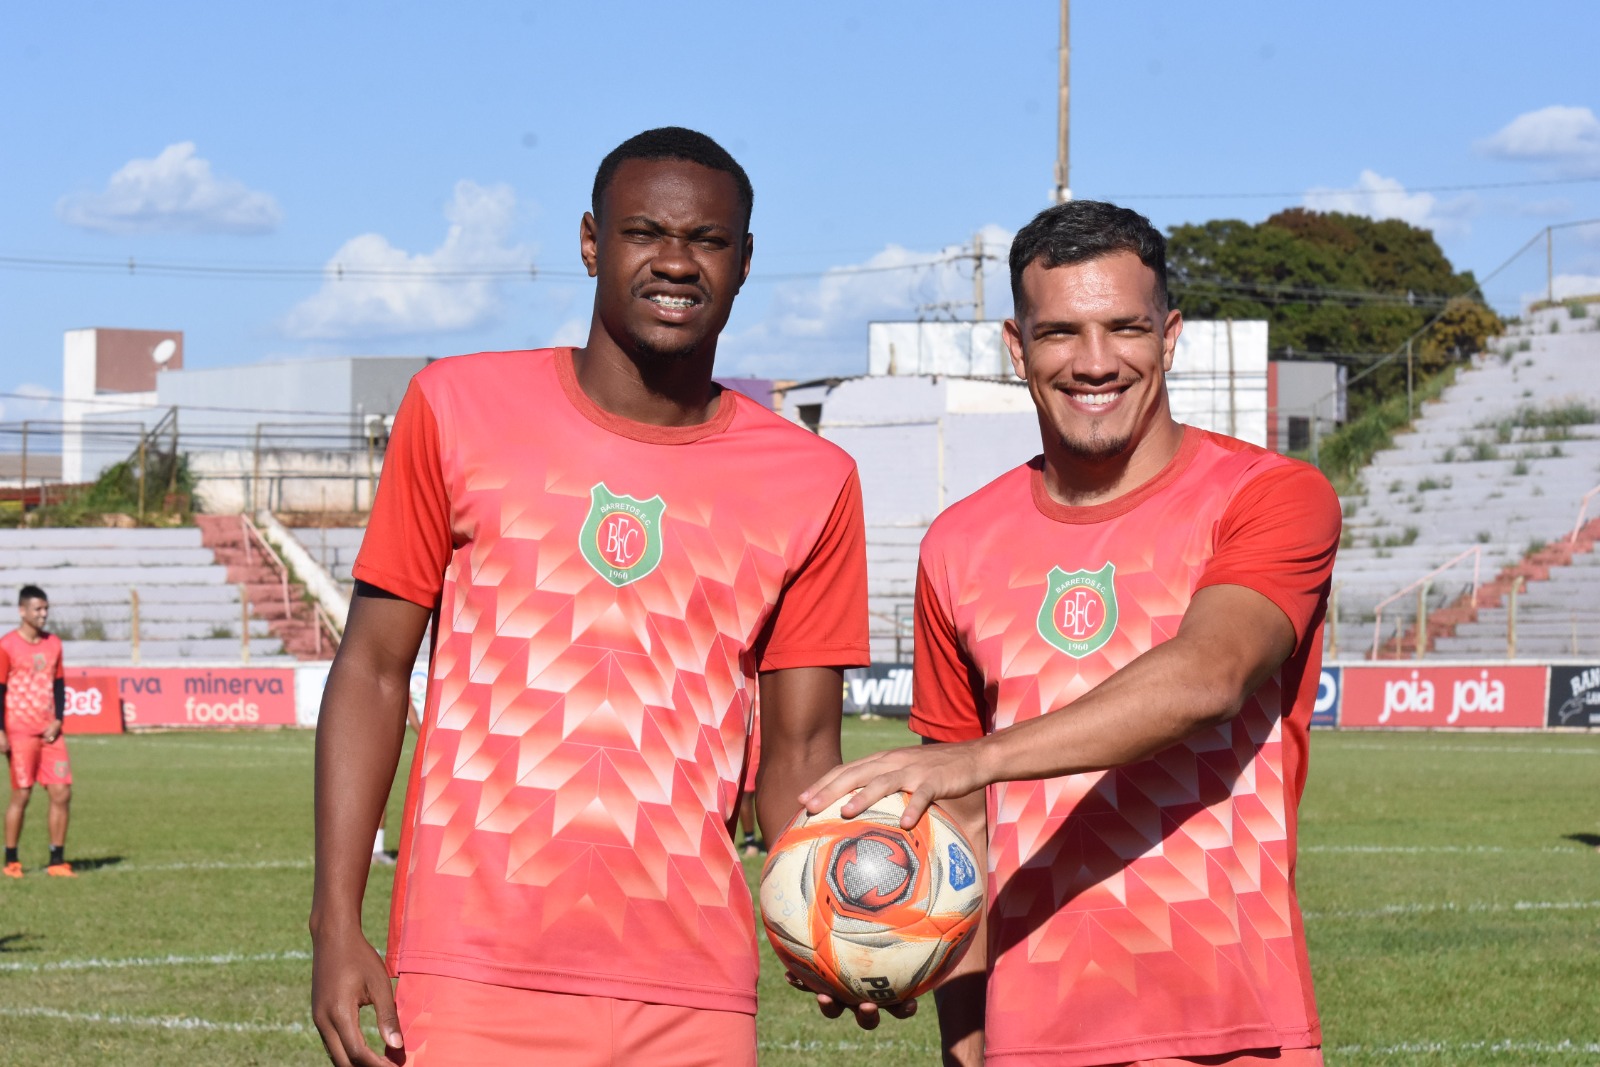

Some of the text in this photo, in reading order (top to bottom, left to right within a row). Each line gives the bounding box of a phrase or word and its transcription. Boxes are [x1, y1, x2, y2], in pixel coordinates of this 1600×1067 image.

[600, 502, 640, 515] BARRETOS
[608, 569, 628, 580] 1960
[1055, 577, 1096, 594] BARRETOS
[1068, 642, 1089, 651] 1960
[184, 672, 284, 695] minerva
[185, 697, 260, 723] foods
